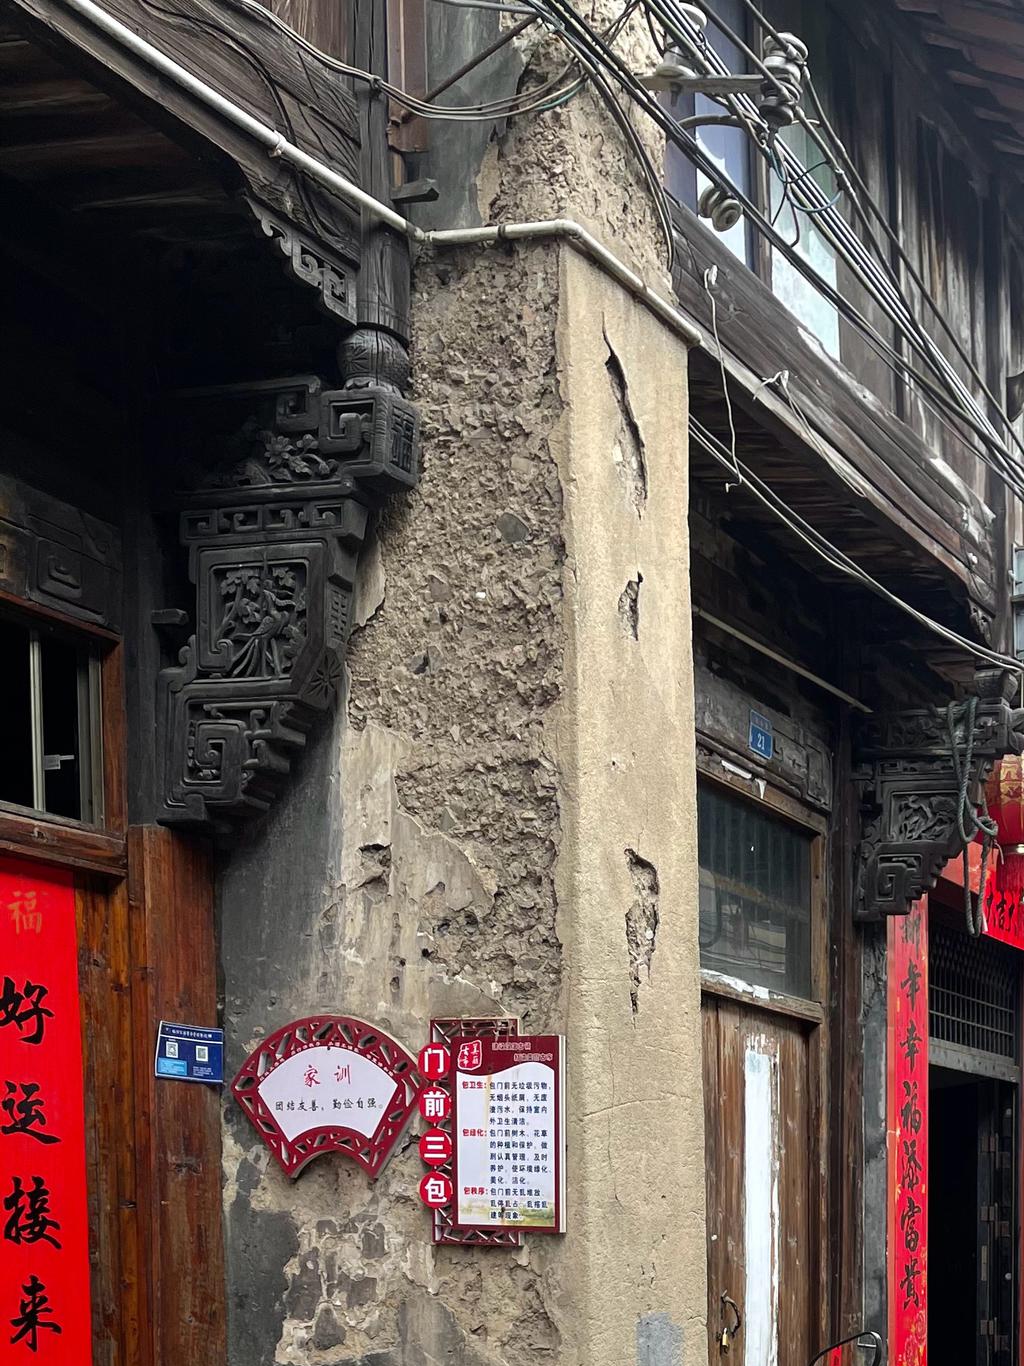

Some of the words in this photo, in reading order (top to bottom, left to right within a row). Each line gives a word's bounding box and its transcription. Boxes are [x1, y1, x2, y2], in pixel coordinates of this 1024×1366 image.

[757, 732, 765, 750] 21
[7, 890, 42, 935] 福
[303, 1064, 351, 1088] 家训
[423, 1048, 447, 1203] 门前三包
